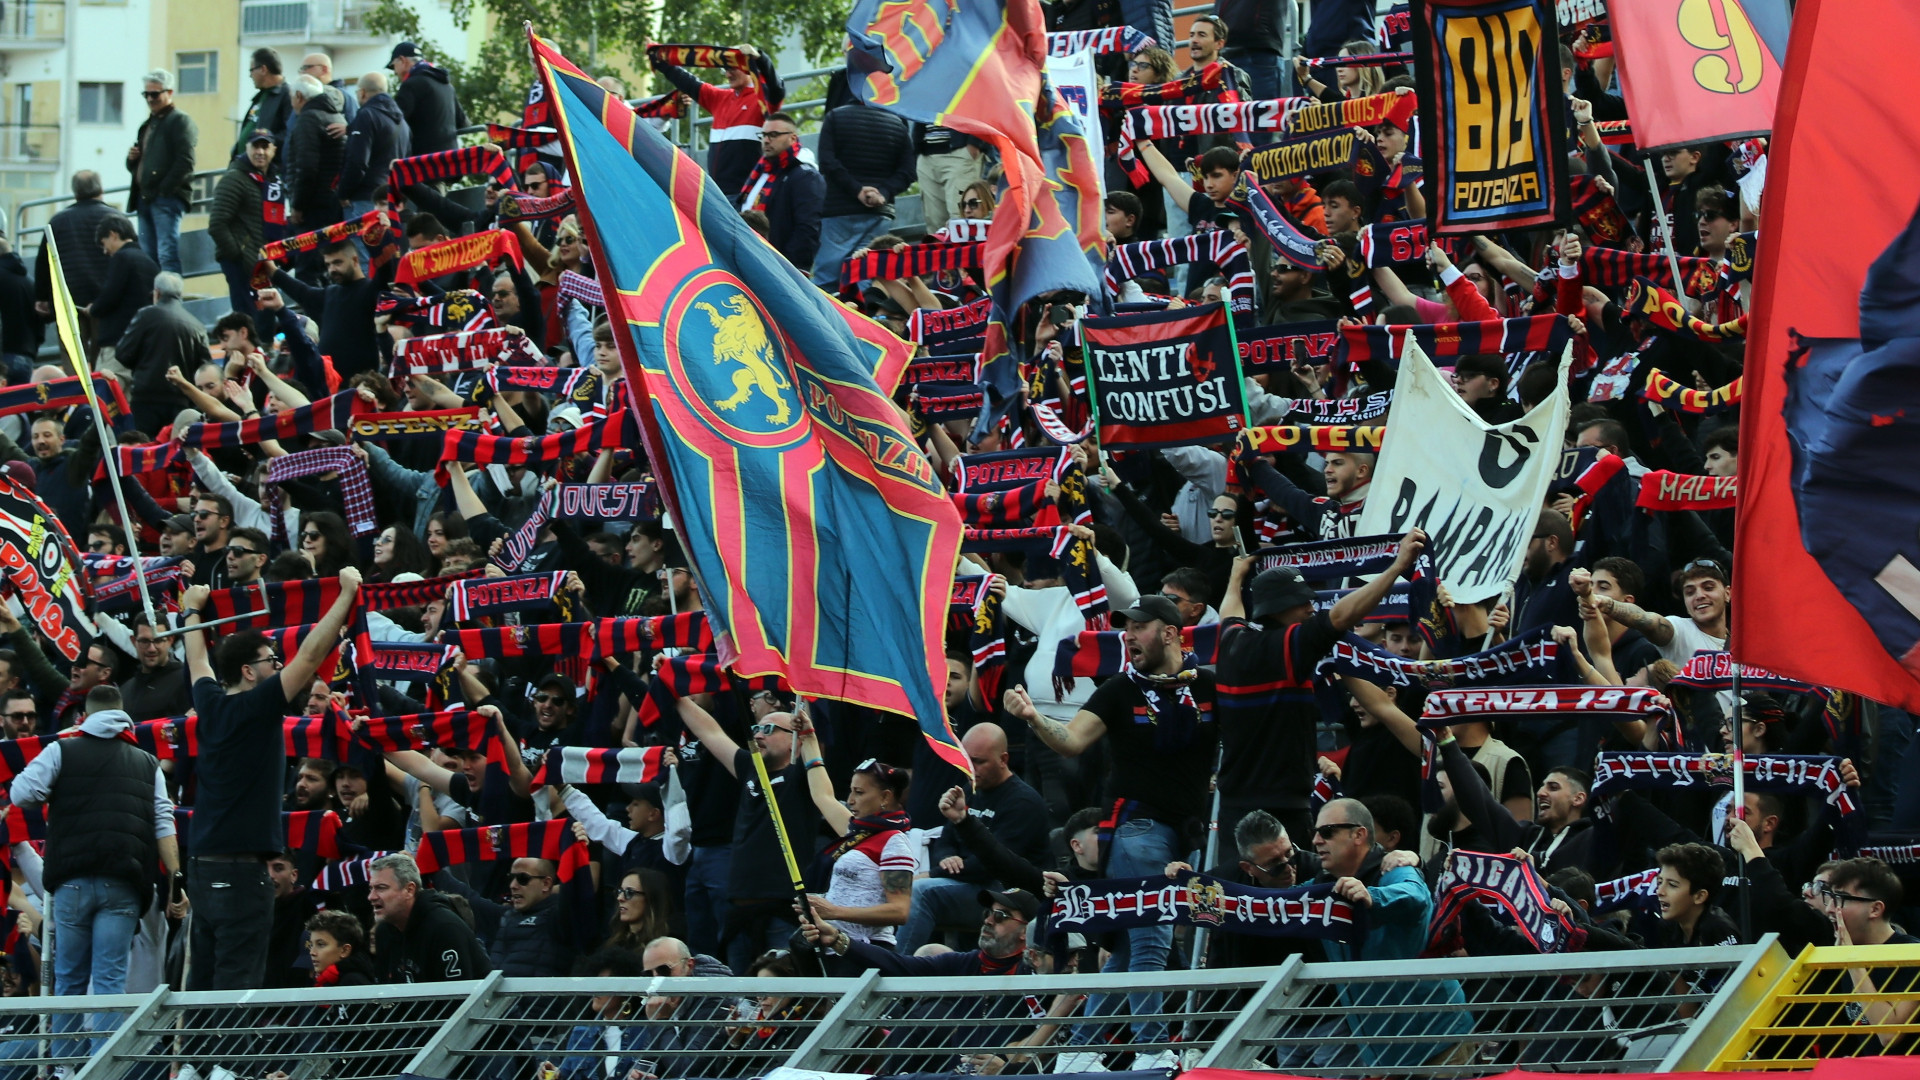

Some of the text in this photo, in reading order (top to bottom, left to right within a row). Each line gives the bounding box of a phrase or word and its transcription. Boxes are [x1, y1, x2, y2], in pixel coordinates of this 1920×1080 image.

[1251, 132, 1355, 181] POTENZA CALCIO
[1454, 171, 1540, 210] POTENZA
[923, 298, 992, 335] POTENZ
[1090, 343, 1190, 383] LENTI
[1106, 376, 1232, 422] CONFUSI
[354, 413, 480, 436] OTENZ
[966, 456, 1056, 489] POTENZA
[467, 576, 550, 609] POTENZA
[441, 948, 462, 979] 2
